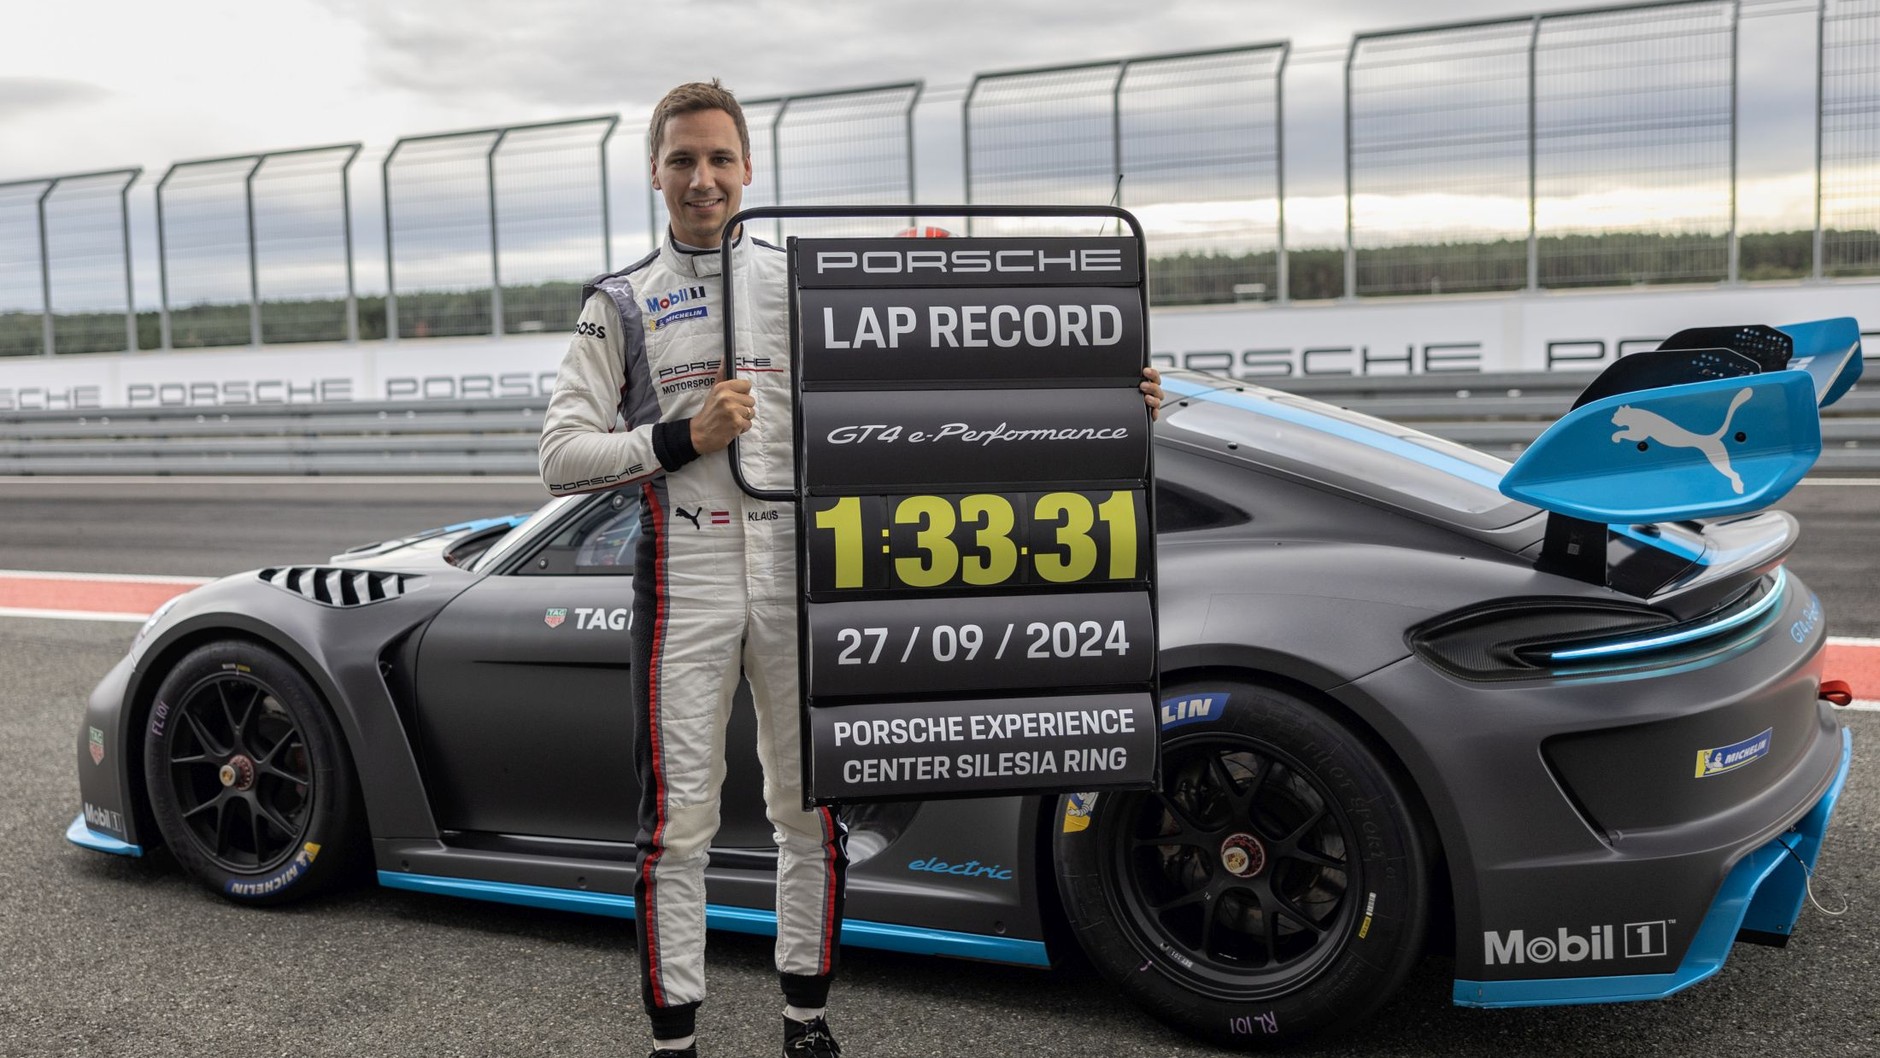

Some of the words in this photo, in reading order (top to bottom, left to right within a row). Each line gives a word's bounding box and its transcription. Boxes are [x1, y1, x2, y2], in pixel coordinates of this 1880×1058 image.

[816, 249, 1121, 274] PORSCHE
[646, 288, 688, 313] Mobil
[666, 310, 703, 323] MICHELIN
[823, 306, 917, 349] LAP
[929, 304, 1123, 348] RECORD
[576, 321, 606, 339] OSS
[658, 357, 771, 379] PORSHE
[128, 378, 352, 408] PORSCHE
[661, 377, 717, 395] MOTORSPOR
[827, 424, 903, 445] GT4
[908, 422, 1129, 446] e-Performance
[549, 463, 644, 491] PORSCHE
[748, 510, 778, 521] KLAUS
[574, 608, 628, 631] TAG
[837, 627, 889, 665] 27
[901, 626, 920, 663] /
[932, 624, 984, 662] 09
[994, 623, 1015, 660] /
[1025, 620, 1130, 659] 2024
[833, 716, 964, 747] PORSCHE
[970, 708, 1135, 741] EXPERIENCE
[1724, 739, 1768, 764] MICHELIN
[843, 756, 951, 784] CENTER
[956, 752, 1057, 778] SILESIA
[1063, 747, 1128, 773] RING
[84, 802, 111, 829] Mobil
[231, 864, 299, 895] MICHELIN
[908, 857, 1013, 880] electric
[1483, 924, 1614, 965] Mobil
[1254, 1011, 1279, 1034] RL
